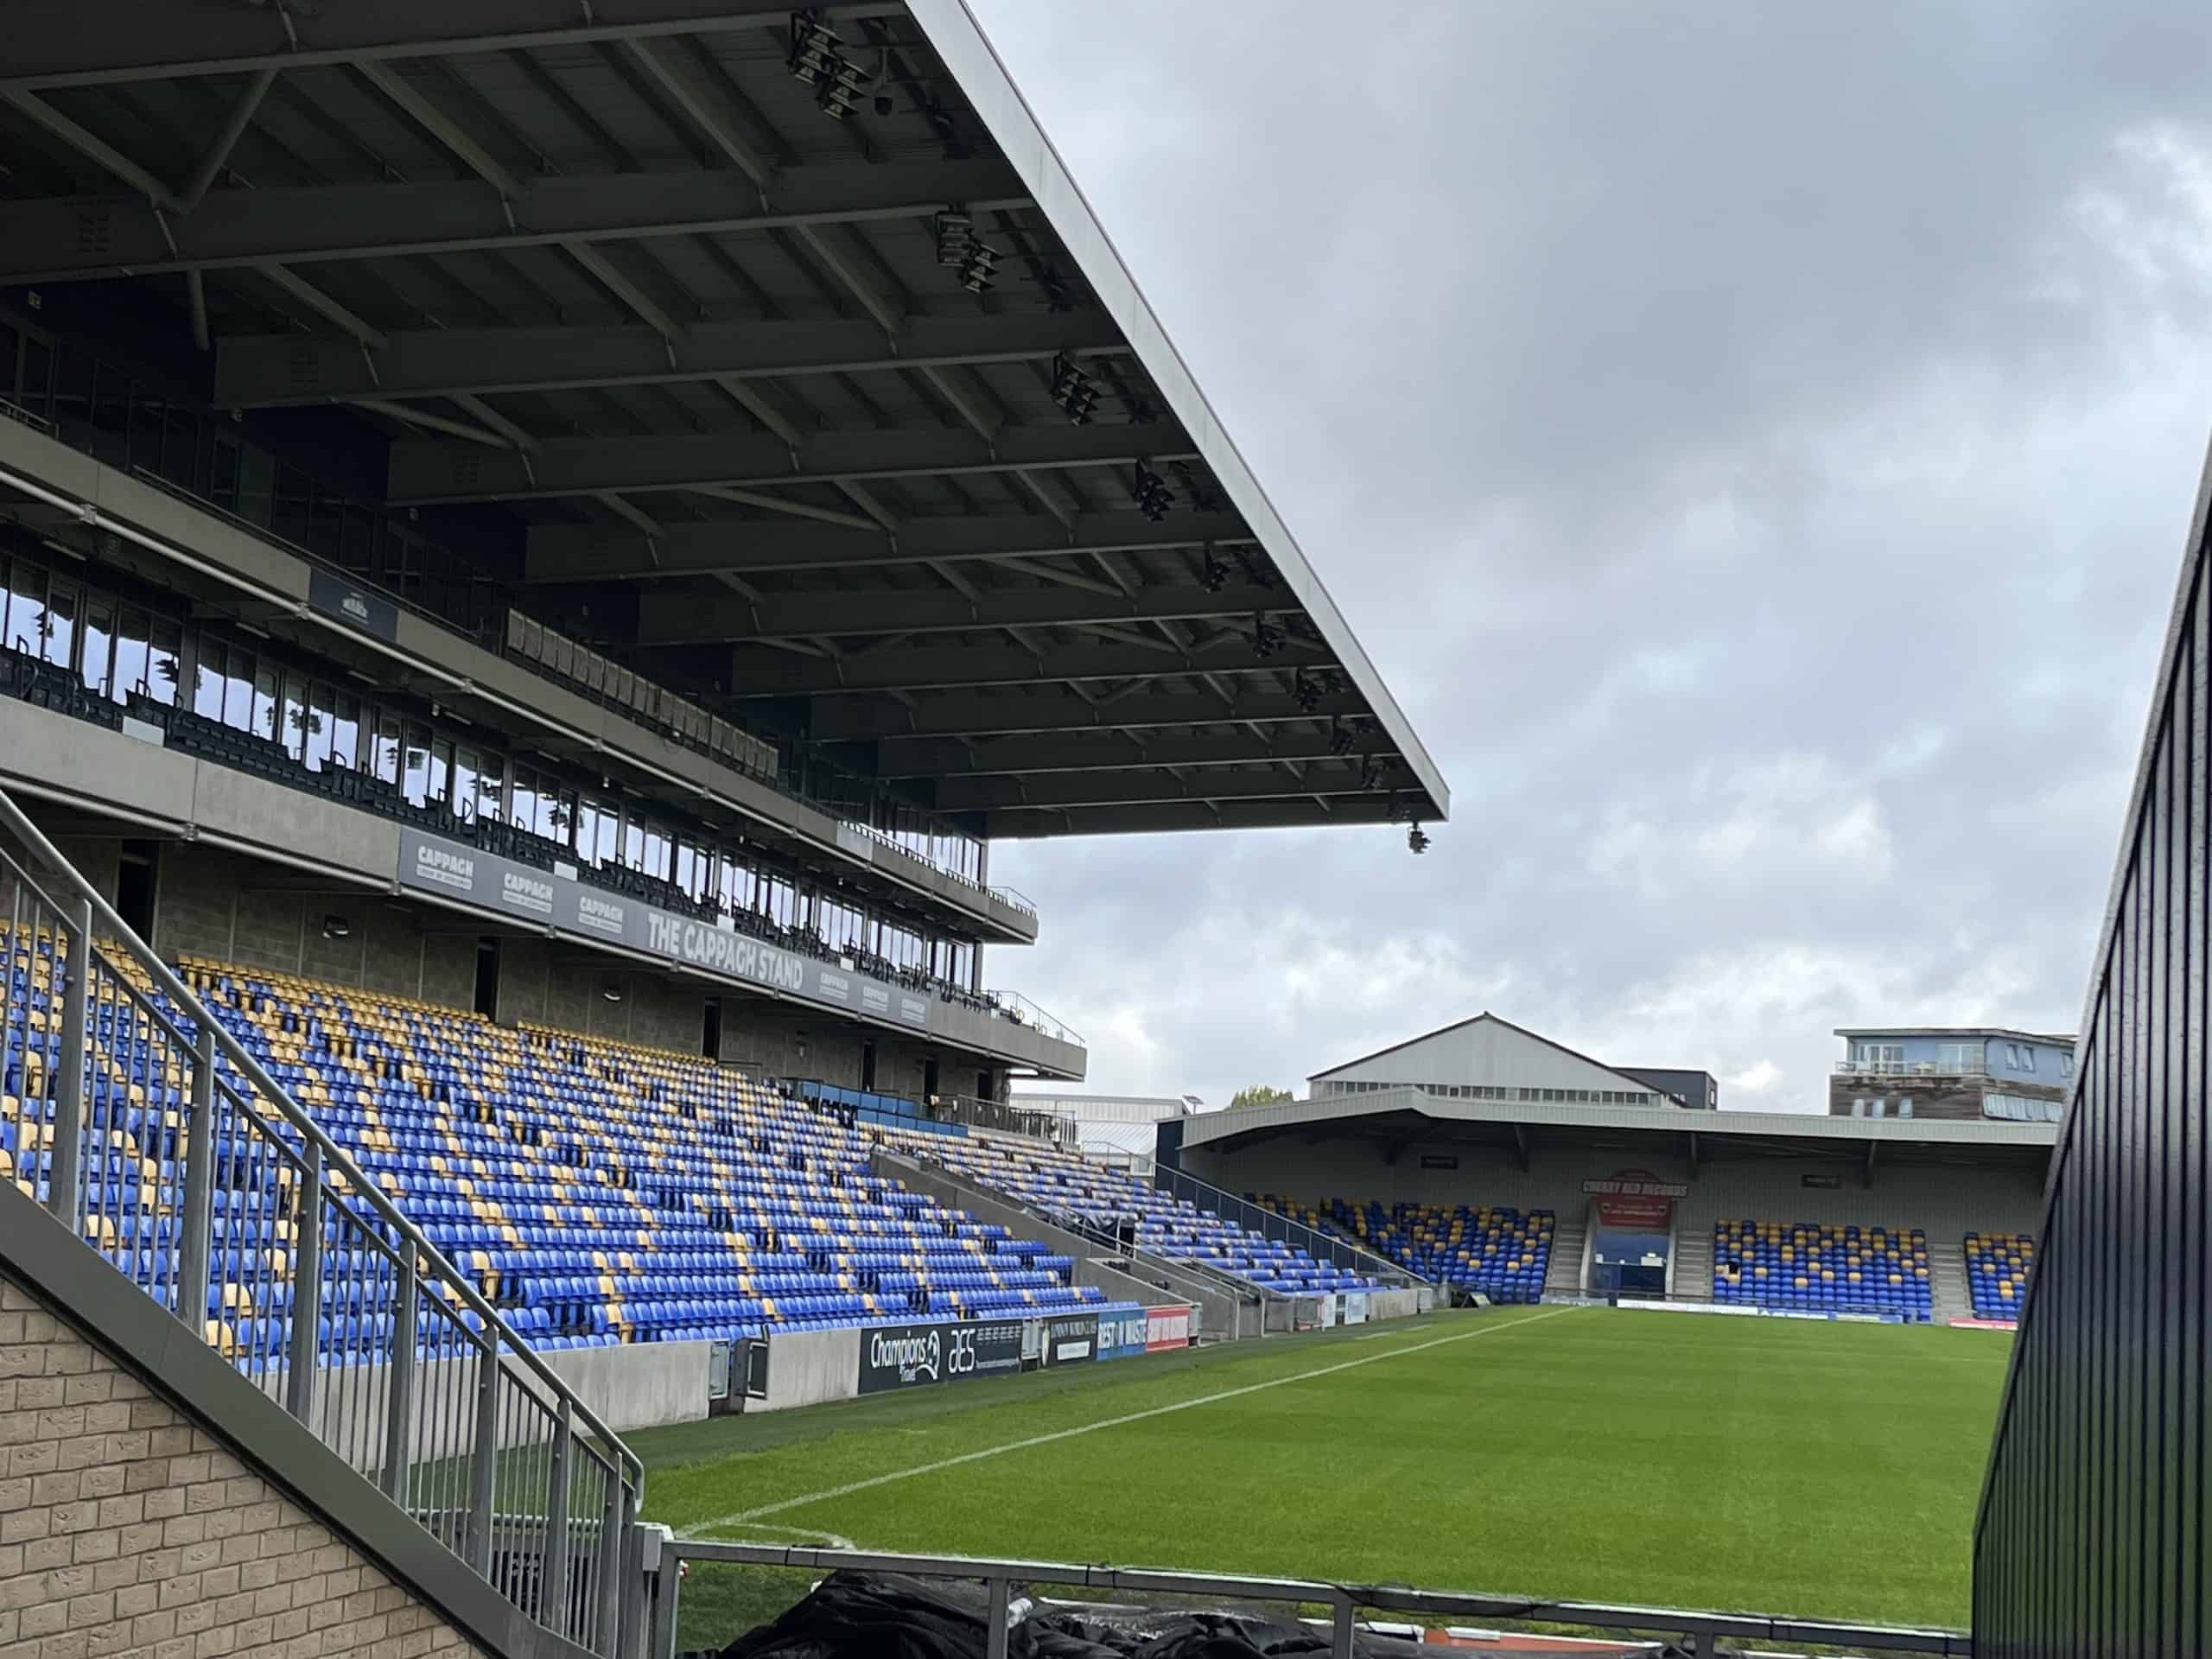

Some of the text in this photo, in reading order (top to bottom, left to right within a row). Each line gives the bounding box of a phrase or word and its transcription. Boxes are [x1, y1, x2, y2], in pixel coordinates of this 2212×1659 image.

[417, 845, 474, 877] CAPPAGH
[504, 873, 554, 902] CAPPAGH
[648, 912, 680, 955] THE
[683, 924, 757, 976] CAPPAGH
[758, 949, 804, 989] STAND
[870, 1330, 927, 1372] Champions
